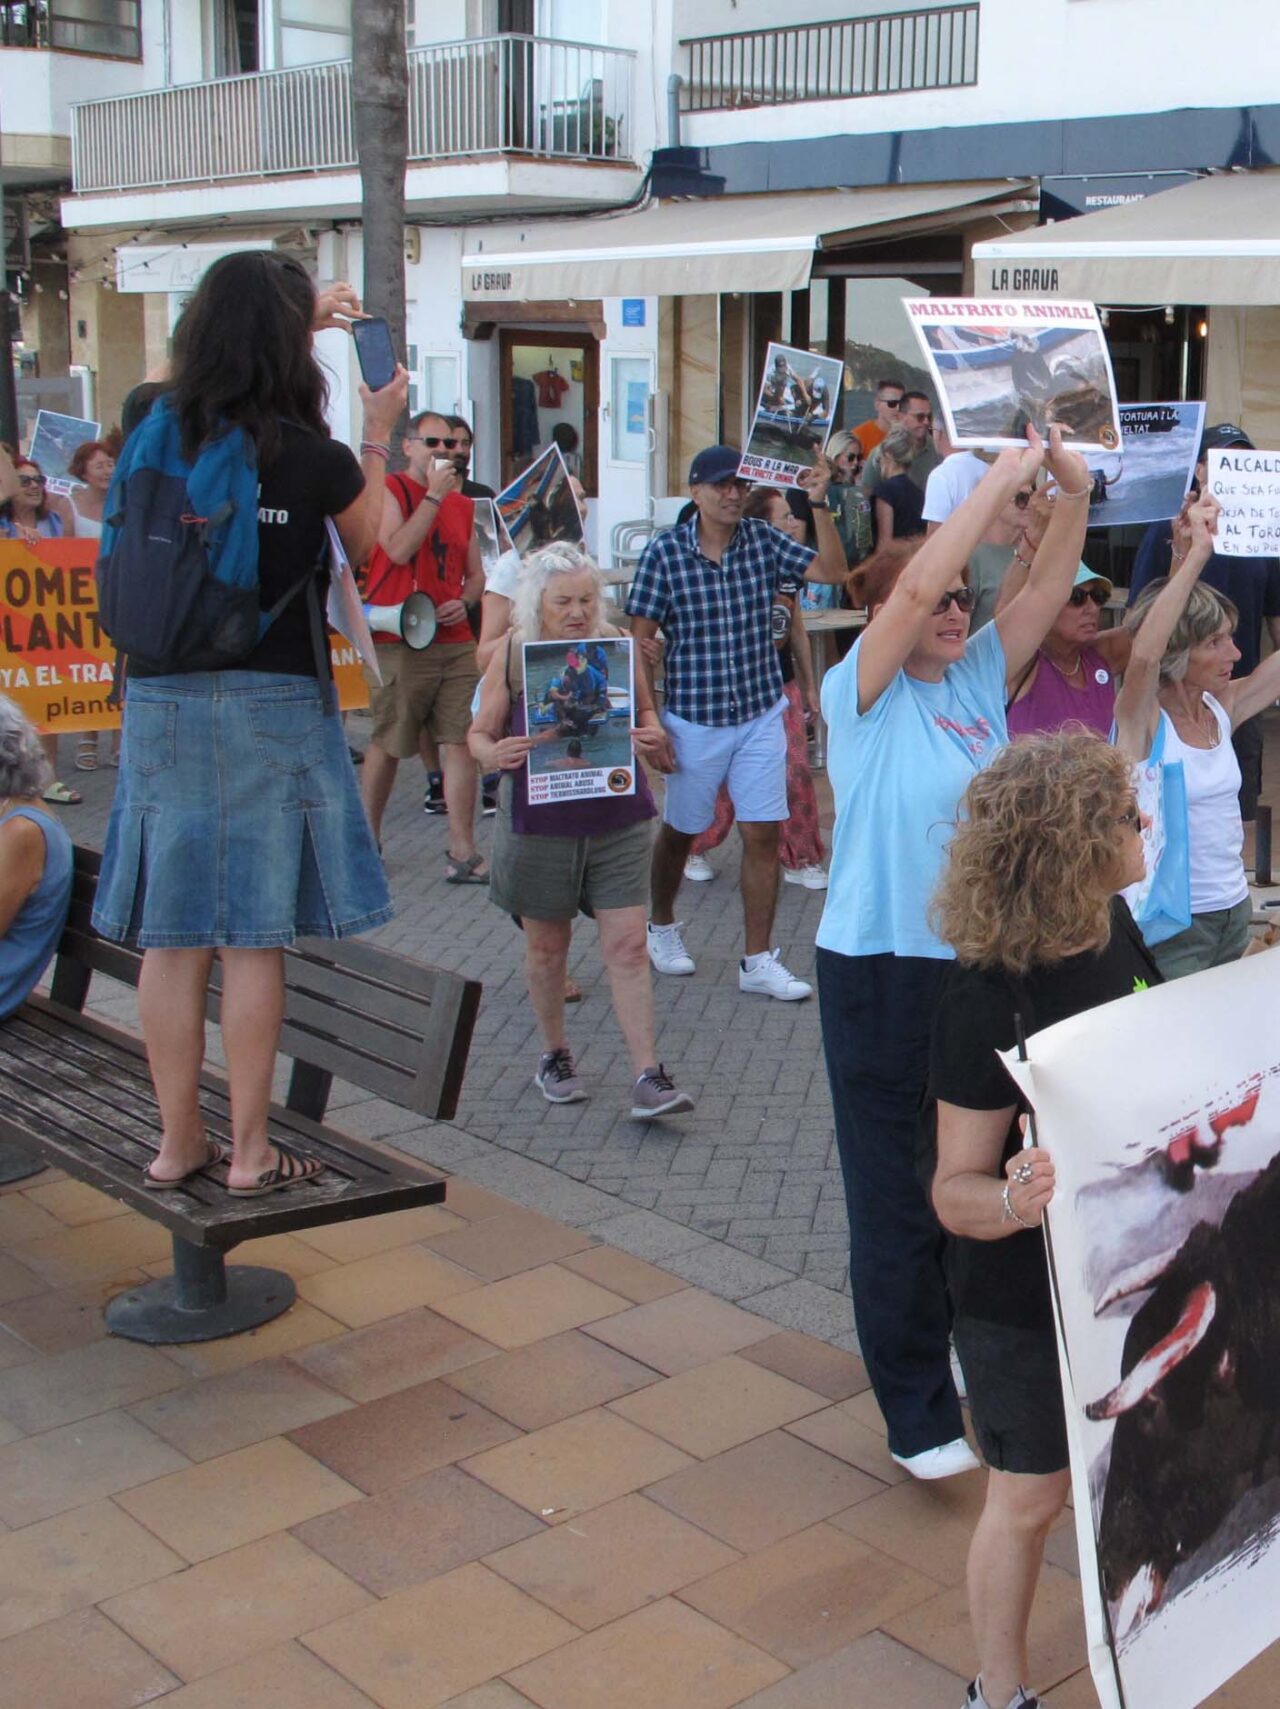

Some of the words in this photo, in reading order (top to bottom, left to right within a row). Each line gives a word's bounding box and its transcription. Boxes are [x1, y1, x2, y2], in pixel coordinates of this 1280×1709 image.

[472, 273, 482, 291] LA
[992, 269, 1009, 291] LA
[908, 302, 1018, 317] MALTRATO
[1022, 304, 1095, 321] ANIMAL
[1120, 411, 1159, 423] TORTURA
[1122, 423, 1151, 435] ELTAT
[743, 455, 763, 467] BOUS
[258, 506, 288, 525] ATO
[1250, 507, 1265, 519] DE
[1226, 523, 1242, 536] AL
[1246, 544, 1260, 555] SU
[0, 610, 104, 653] LANT
[0, 667, 31, 689] YA
[36, 665, 62, 687] EL
[69, 661, 117, 684] TRA
